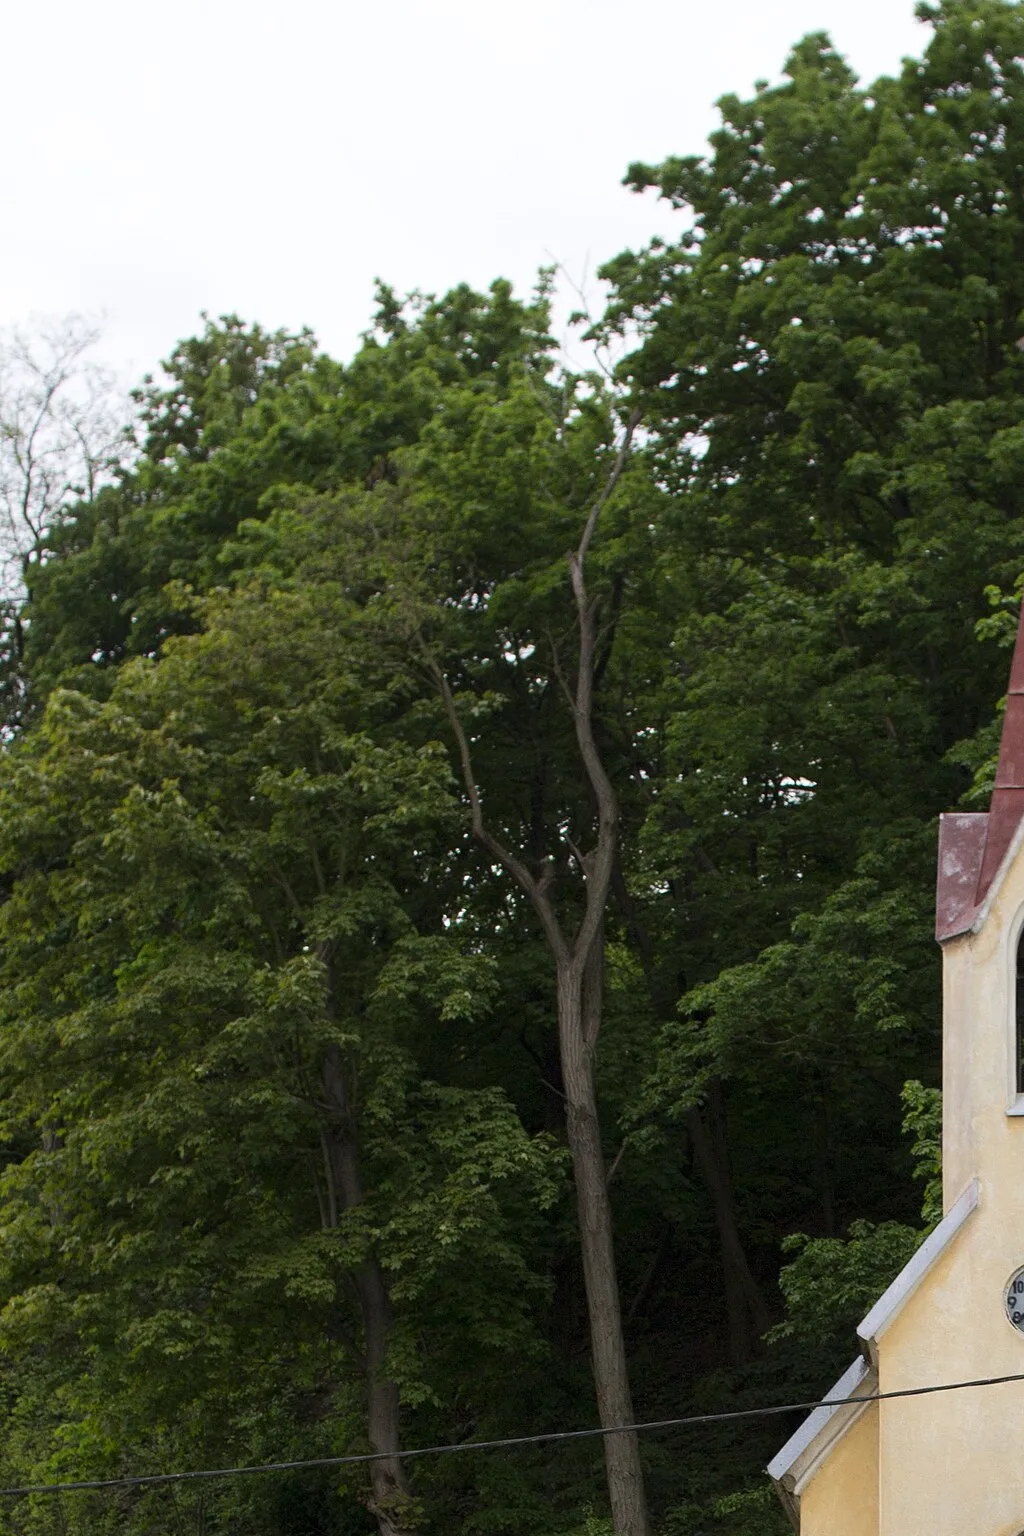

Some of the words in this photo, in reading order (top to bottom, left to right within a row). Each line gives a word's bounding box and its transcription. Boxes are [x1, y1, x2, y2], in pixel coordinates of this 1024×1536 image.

[1012, 1281, 1024, 1293] 10
[1007, 1296, 1017, 1309] 9
[1012, 1311, 1021, 1324] 8
